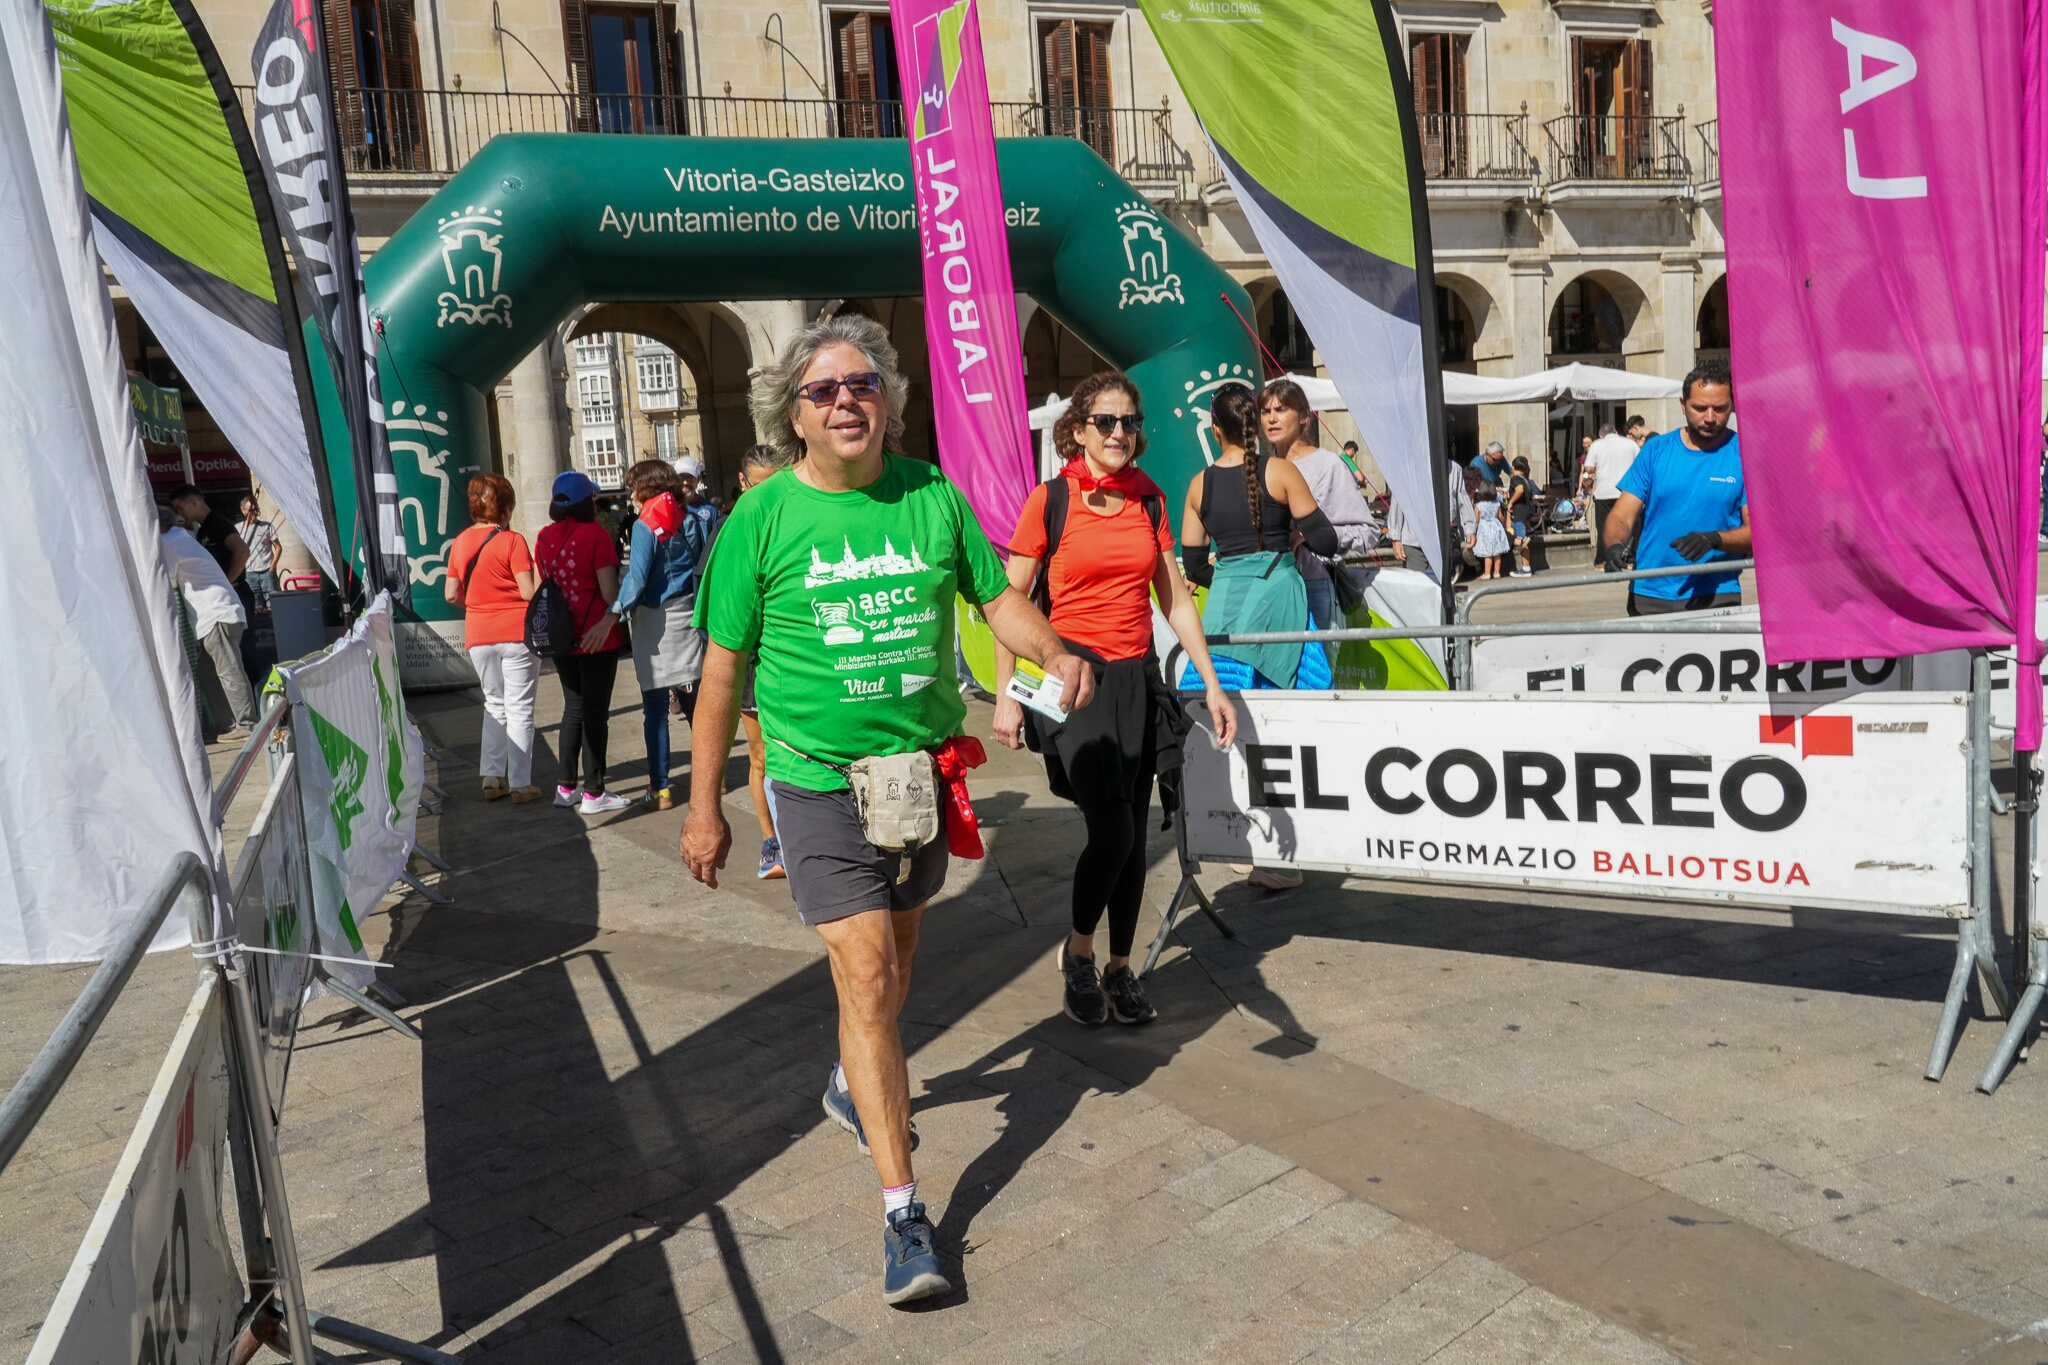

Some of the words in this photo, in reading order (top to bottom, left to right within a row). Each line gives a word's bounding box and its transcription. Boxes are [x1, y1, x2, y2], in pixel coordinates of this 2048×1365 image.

[663, 167, 905, 192] Vitoria-Gasteizko
[599, 205, 797, 240] Ayuntamiento
[806, 205, 840, 231] de
[195, 458, 240, 473] Optika
[858, 586, 918, 610] aecc
[864, 606, 892, 617] ARABA
[869, 618, 889, 631] en
[893, 606, 937, 627] marcha
[405, 634, 460, 643] Ayuntamiento
[872, 625, 919, 643] martxan
[417, 642, 465, 651] Vitoria-Gaste
[848, 654, 877, 663] Marcha
[878, 650, 903, 659] Contra
[904, 647, 911, 655] el
[834, 660, 876, 671] Minbiziaren
[877, 656, 906, 666] aurkako
[1346, 665, 1367, 678] para
[1368, 666, 1377, 679] ti
[843, 676, 886, 696] Vital
[1245, 744, 1350, 811] EL
[1364, 746, 1808, 832] CORREO
[1366, 838, 1577, 870] INFORMAZIO
[1593, 850, 1811, 886] BALIOTSUA
